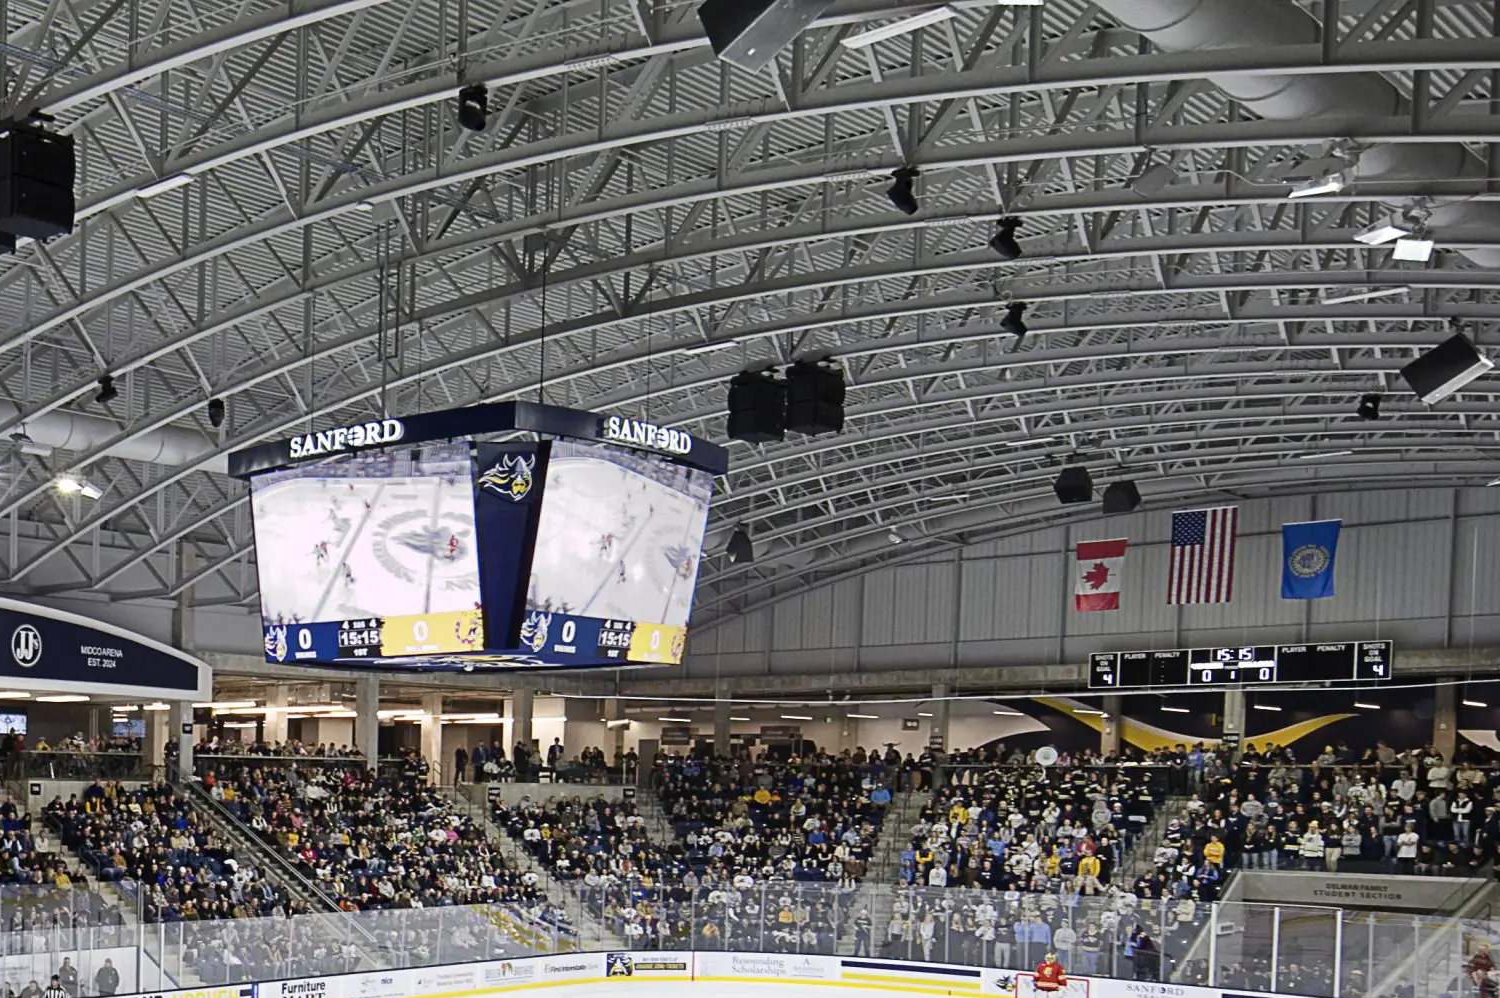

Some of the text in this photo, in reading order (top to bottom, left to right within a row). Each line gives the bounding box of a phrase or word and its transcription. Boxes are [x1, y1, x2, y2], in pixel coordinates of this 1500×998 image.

[290, 419, 405, 458] SANFORD
[609, 416, 692, 454] SANFORD
[412, 620, 429, 642] 0
[562, 620, 576, 643] 0
[299, 628, 312, 650] 0
[341, 630, 380, 646] 15:15
[601, 630, 631, 647] 15:15
[650, 629, 661, 650] 0
[81, 645, 123, 658] MIDCO ARENA
[1282, 644, 1346, 654] PLAYER PENALTY
[1363, 643, 1386, 651] SHOTS
[1124, 651, 1181, 660] PLAYER PENALTY
[1202, 669, 1212, 683] 0
[1259, 667, 1270, 680] 0
[1373, 664, 1384, 677] 4
[1102, 673, 1113, 685] 4
[1313, 889, 1403, 901] STUDENT SECTION
[731, 955, 785, 968] Resounding
[731, 964, 787, 976] Scholarships
[281, 981, 326, 994] Furniture
[1125, 983, 1184, 996] SANFORD
